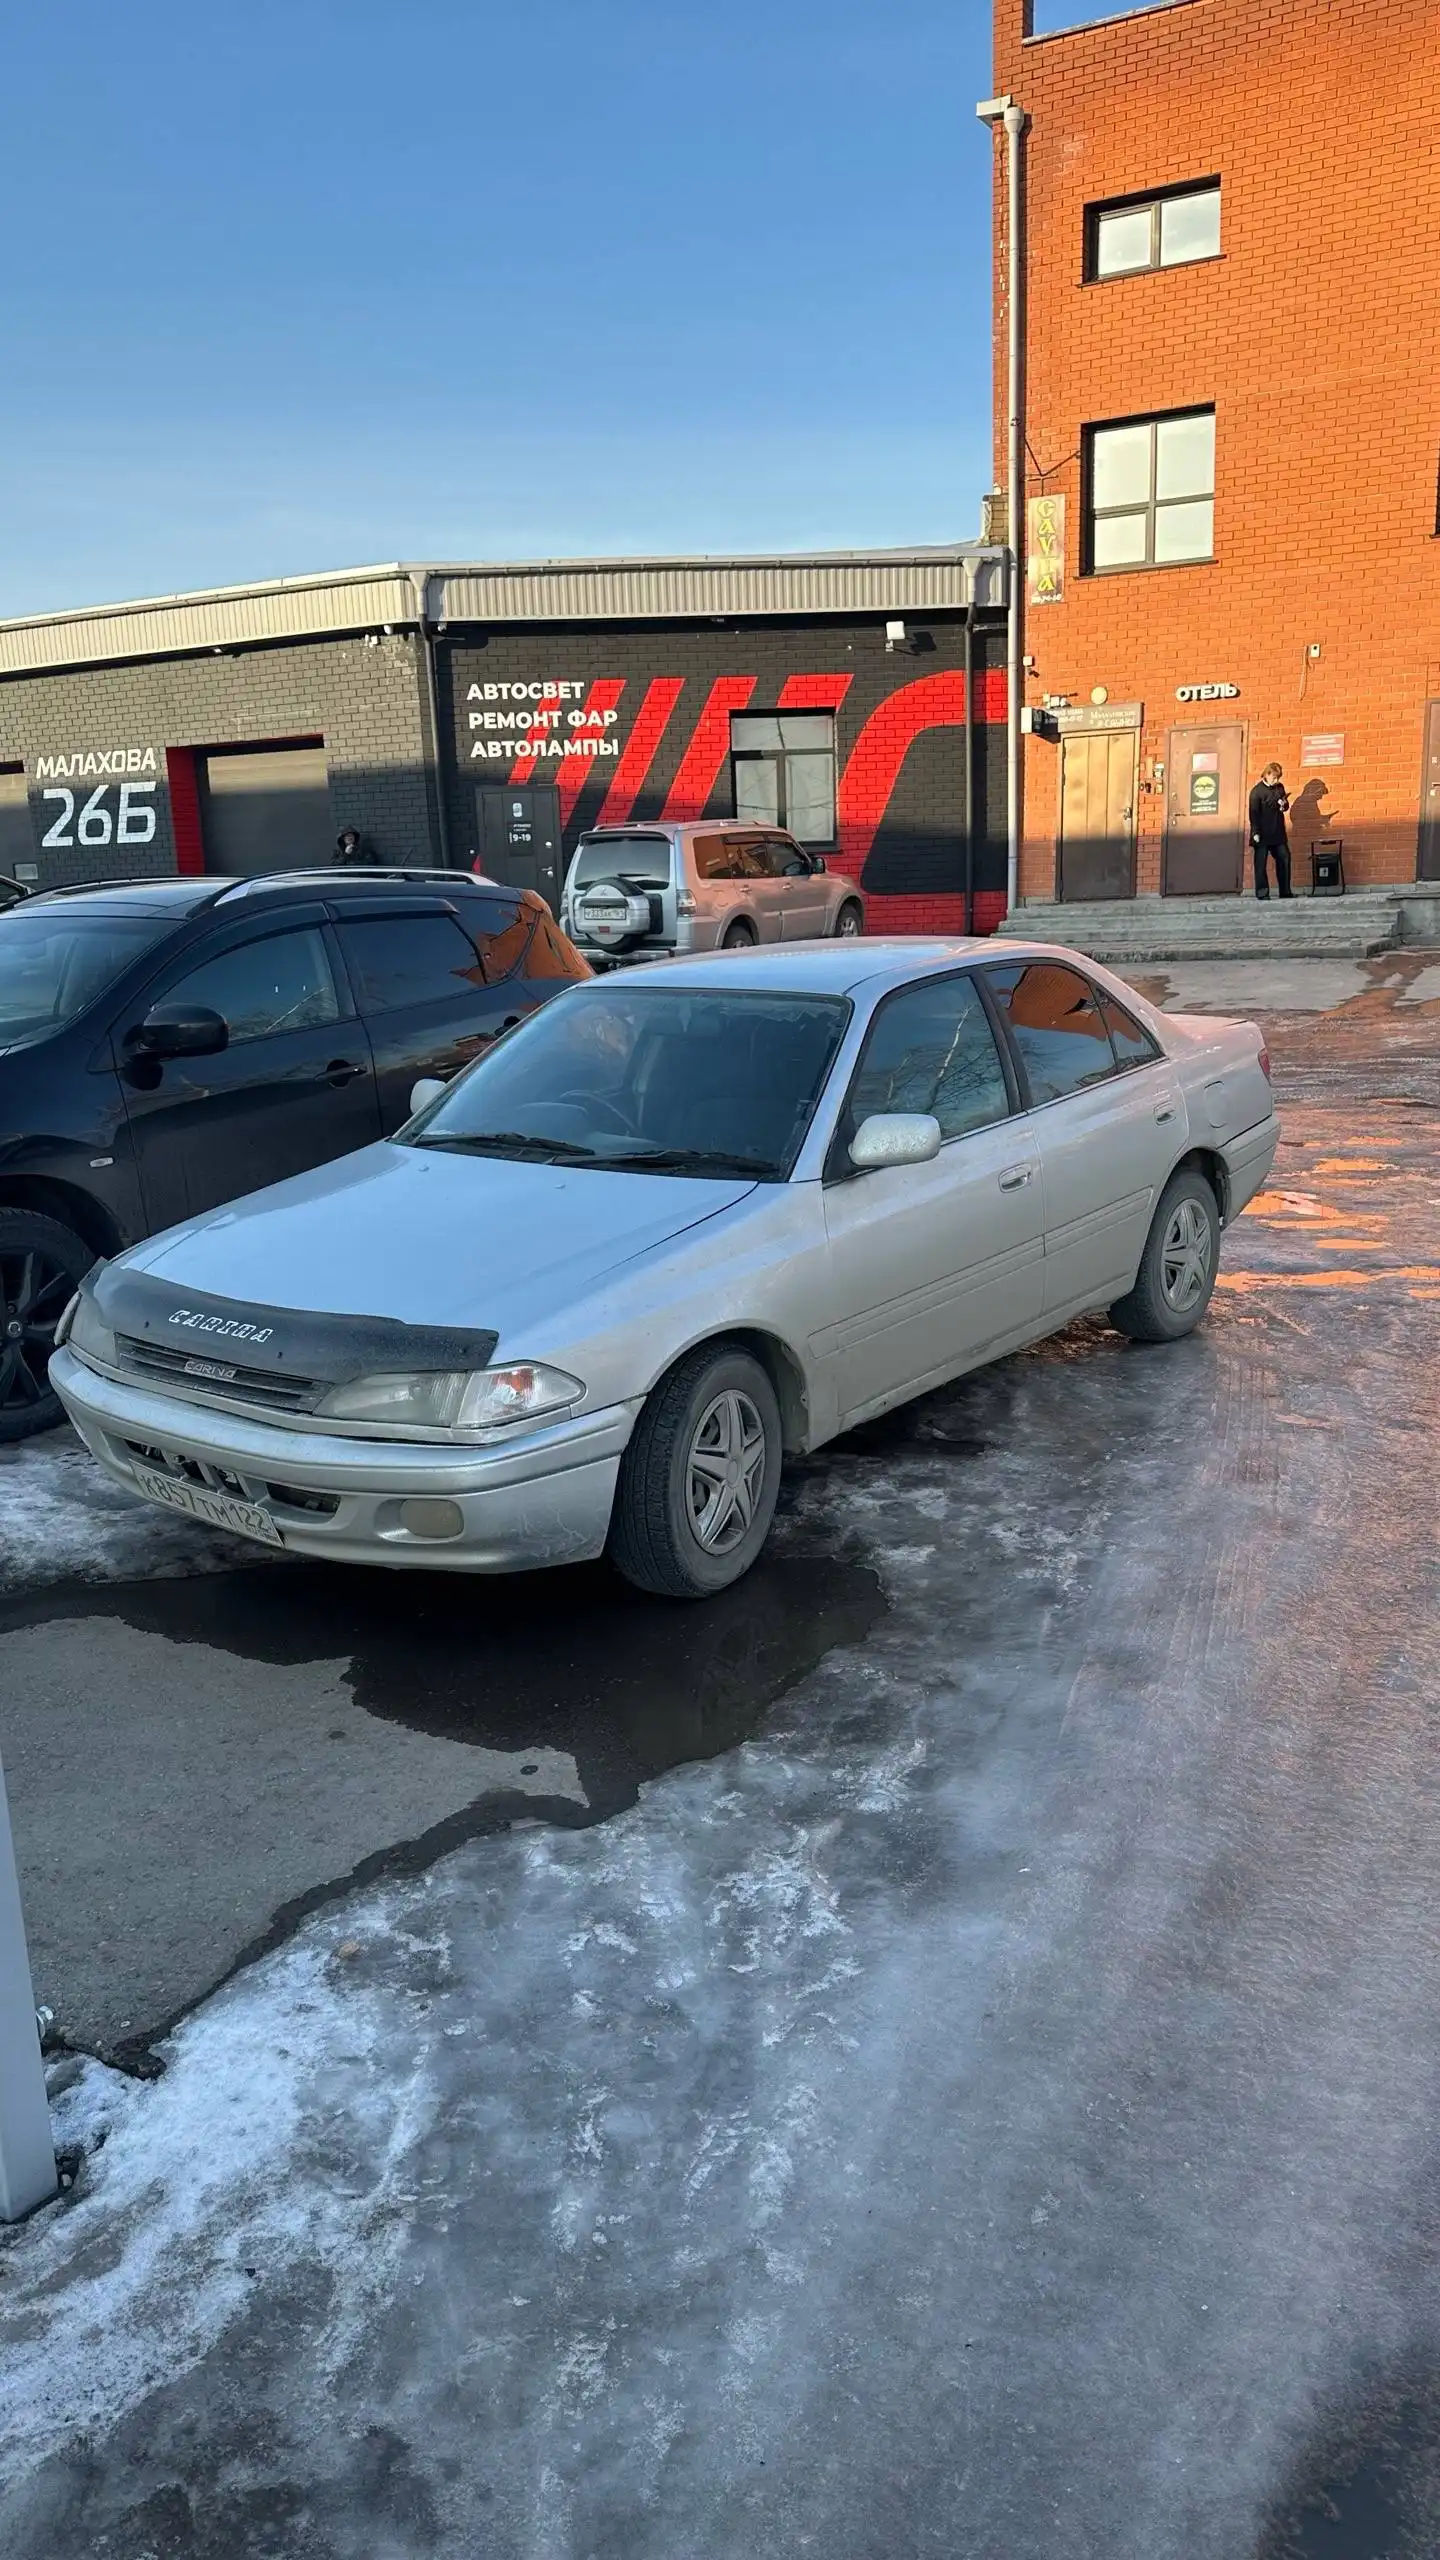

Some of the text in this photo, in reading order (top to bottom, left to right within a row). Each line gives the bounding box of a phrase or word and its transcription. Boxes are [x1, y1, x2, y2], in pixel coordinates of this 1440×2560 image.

[1037, 499, 1056, 592] САУА
[467, 682, 584, 700] АВТОСВЕТ
[1176, 683, 1239, 701] ОТЕЛЬ
[469, 710, 618, 729] РЕМОНТ ФАР
[470, 739, 619, 758] АВТОЛАМПЫ
[36, 748, 156, 779] МАЛАХОВА
[41, 781, 157, 847] 26Б
[168, 1310, 273, 1342] CARINA
[184, 1361, 236, 1379] CARINA
